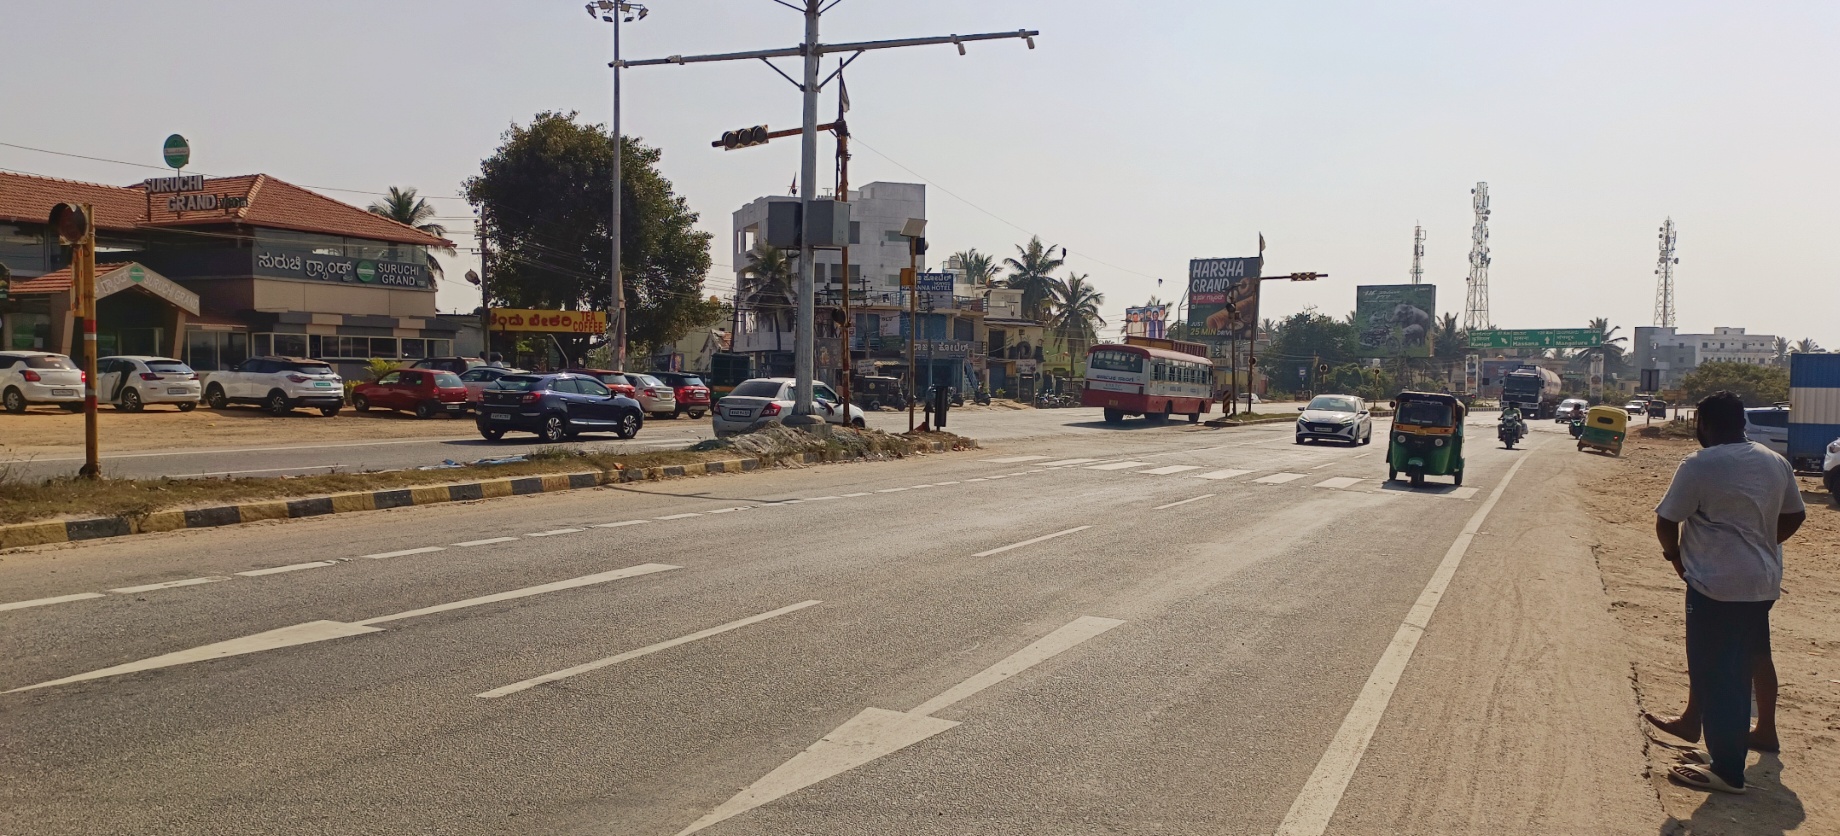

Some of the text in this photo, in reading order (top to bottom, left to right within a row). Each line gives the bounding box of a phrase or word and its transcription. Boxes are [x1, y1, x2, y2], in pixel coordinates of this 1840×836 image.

[144, 175, 204, 193] SURUCHI
[167, 195, 217, 212] GRAND
[258, 252, 301, 269] ಸುರುಚಿ
[378, 263, 419, 276] SURUCHI
[1192, 260, 1244, 278] HARSHA
[382, 275, 415, 286] GRAND
[1192, 278, 1230, 292] GRAND
[144, 274, 199, 310] SURUCHI GRAND
[529, 313, 573, 328] ಬೇಕರಿ
[581, 311, 596, 322] TEA
[573, 320, 603, 333] COFFEE
[1190, 328, 1200, 336] 25
[1201, 327, 1217, 336] MIN
